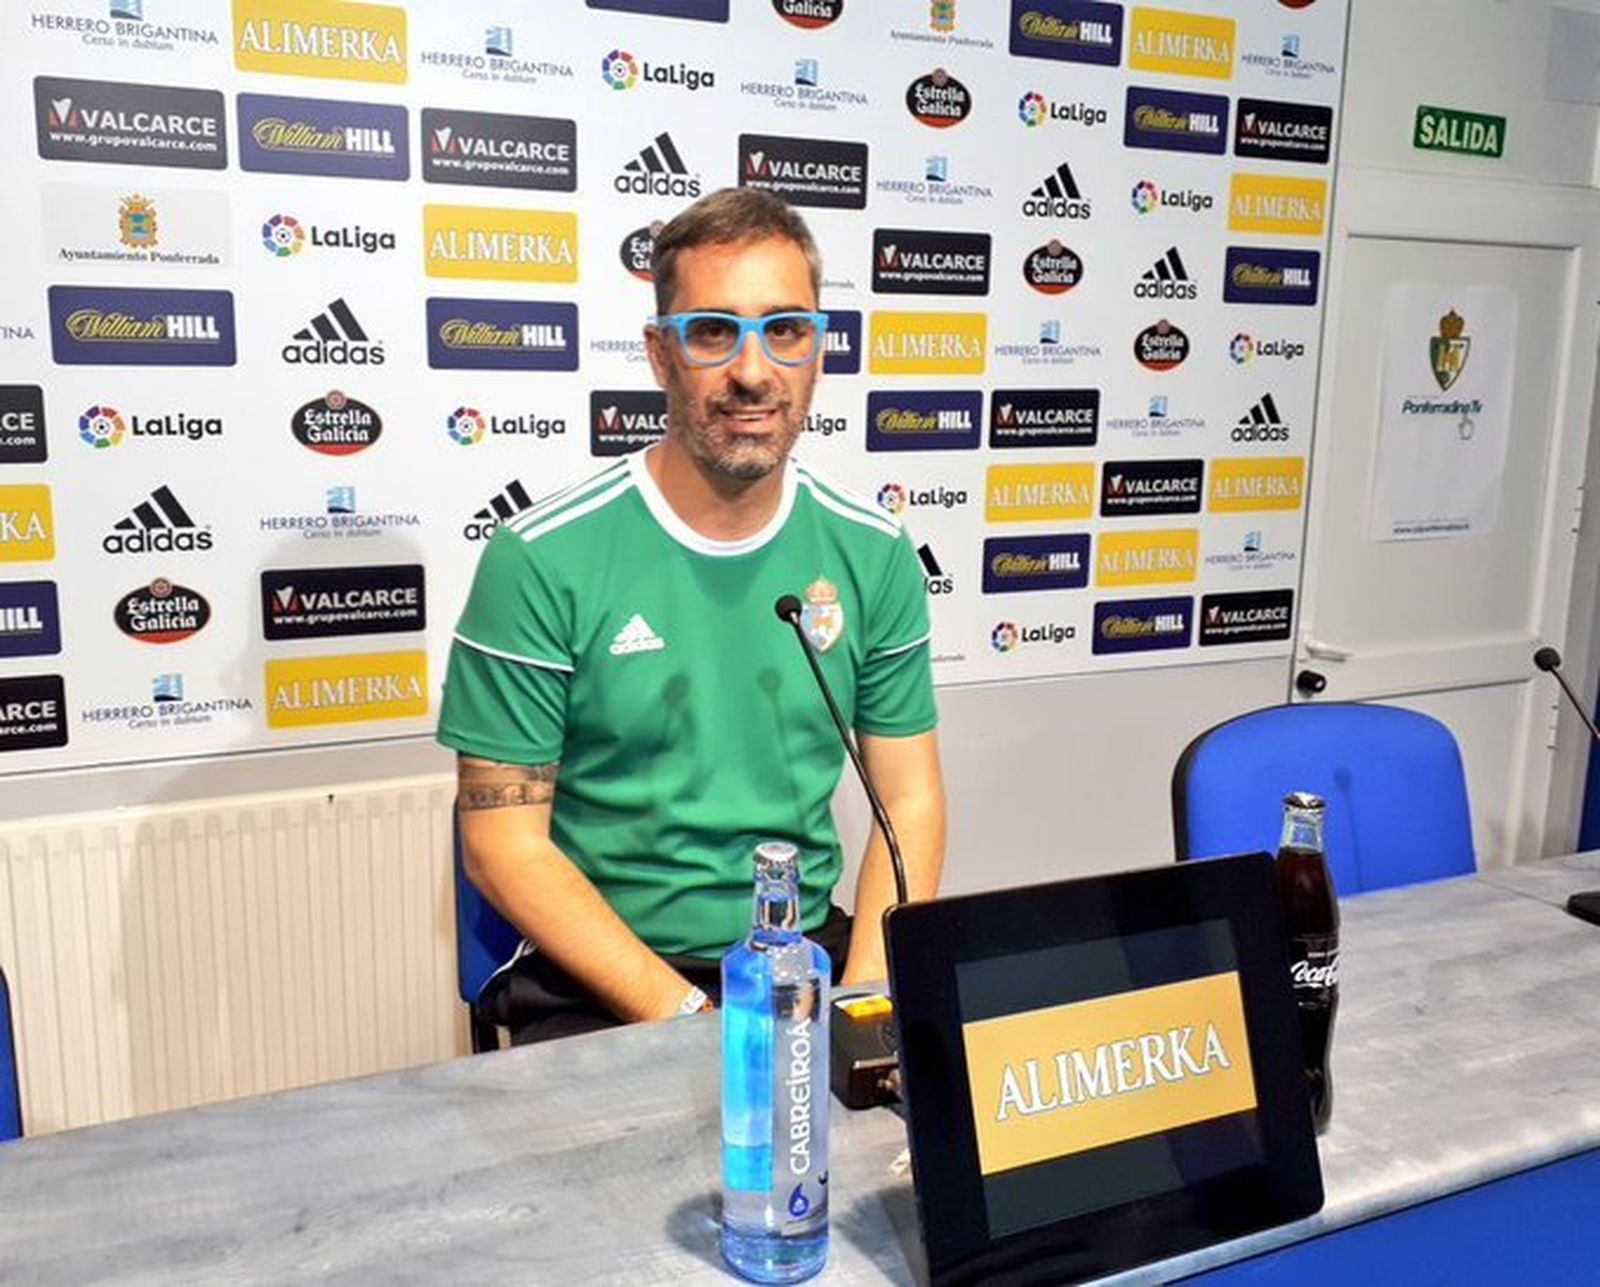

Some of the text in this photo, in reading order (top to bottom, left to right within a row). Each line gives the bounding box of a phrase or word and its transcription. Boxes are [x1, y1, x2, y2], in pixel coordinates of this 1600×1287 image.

[32, 14, 219, 44] HERRERO BRIGANTINA
[1019, 10, 1113, 45] William HILL
[240, 19, 402, 65] ALIMERKA
[1134, 30, 1231, 62] ALIMERKA
[422, 52, 574, 78] HERRERO BRIGANTINA
[643, 61, 715, 91] LaLiga
[741, 82, 868, 106] HERRERO BRIGANTINA
[915, 82, 965, 103] Estrella
[916, 99, 962, 117] Galicia
[1050, 101, 1107, 126] LaLiga
[1135, 104, 1219, 134] William HILL
[80, 109, 217, 136] VALCARCE
[1258, 120, 1328, 141] VALCARCE
[1418, 114, 1499, 154] SALIDA
[49, 131, 218, 152] www.grupovalcarce.com
[252, 117, 395, 153] William HILL
[458, 136, 569, 162] VALCARCE
[432, 158, 569, 176] www.grupovalcarce.com
[768, 160, 862, 183] VALCARCE
[614, 170, 701, 198] adidas
[877, 179, 993, 198] HERRERO BRIGANTINA
[1022, 198, 1092, 220] adidas
[1161, 189, 1213, 213] LaLiga
[1232, 191, 1322, 222] ALIMERKA
[311, 225, 396, 253] LaLiga
[430, 230, 573, 265] ALIMERKA
[59, 247, 220, 265] Ayuntamiento Ponferrada
[900, 251, 985, 271] VALCARCE
[1032, 254, 1078, 272] Estrella
[1033, 268, 1075, 285] Galicia
[1283, 268, 1312, 286] HILL
[1133, 280, 1198, 301] adidas
[65, 309, 220, 342] William HILL
[439, 318, 567, 349] William HILL
[282, 340, 386, 366] adidas
[825, 331, 851, 352] ILL
[875, 333, 981, 362] ALIMERKA
[1256, 340, 1305, 361] LaLiga
[131, 413, 223, 441] LaLiga
[303, 408, 372, 427] Estrella
[491, 414, 566, 439] LaLiga
[876, 406, 973, 434] William HILL
[1016, 408, 1094, 427] VALCARCE
[307, 423, 370, 444] Galicia
[1231, 422, 1290, 443] adidas
[909, 486, 968, 509] LaLiga
[989, 481, 1090, 508] ALIMERKA
[1125, 476, 1198, 495] VALCARCE
[1212, 476, 1300, 500] ALIMERKA
[260, 513, 419, 532] HERRERO BRIGANTINA
[102, 527, 213, 555] adidas
[991, 551, 1081, 578] William HILL
[1101, 546, 1196, 574] ALIMERKA
[126, 597, 199, 617] Estrella
[301, 587, 418, 611] VALCARCE
[130, 613, 197, 632] Galicia
[273, 607, 418, 625] www.grupovalcarce.com
[1154, 613, 1185, 633] HILL
[1221, 606, 1289, 625] VALCARCE
[1021, 623, 1076, 644] LaLiga
[274, 674, 422, 713] ALIMERKA
[82, 697, 253, 723] HERRERO BRIGANTINA
[995, 1019, 1231, 1123] ALIMERKA
